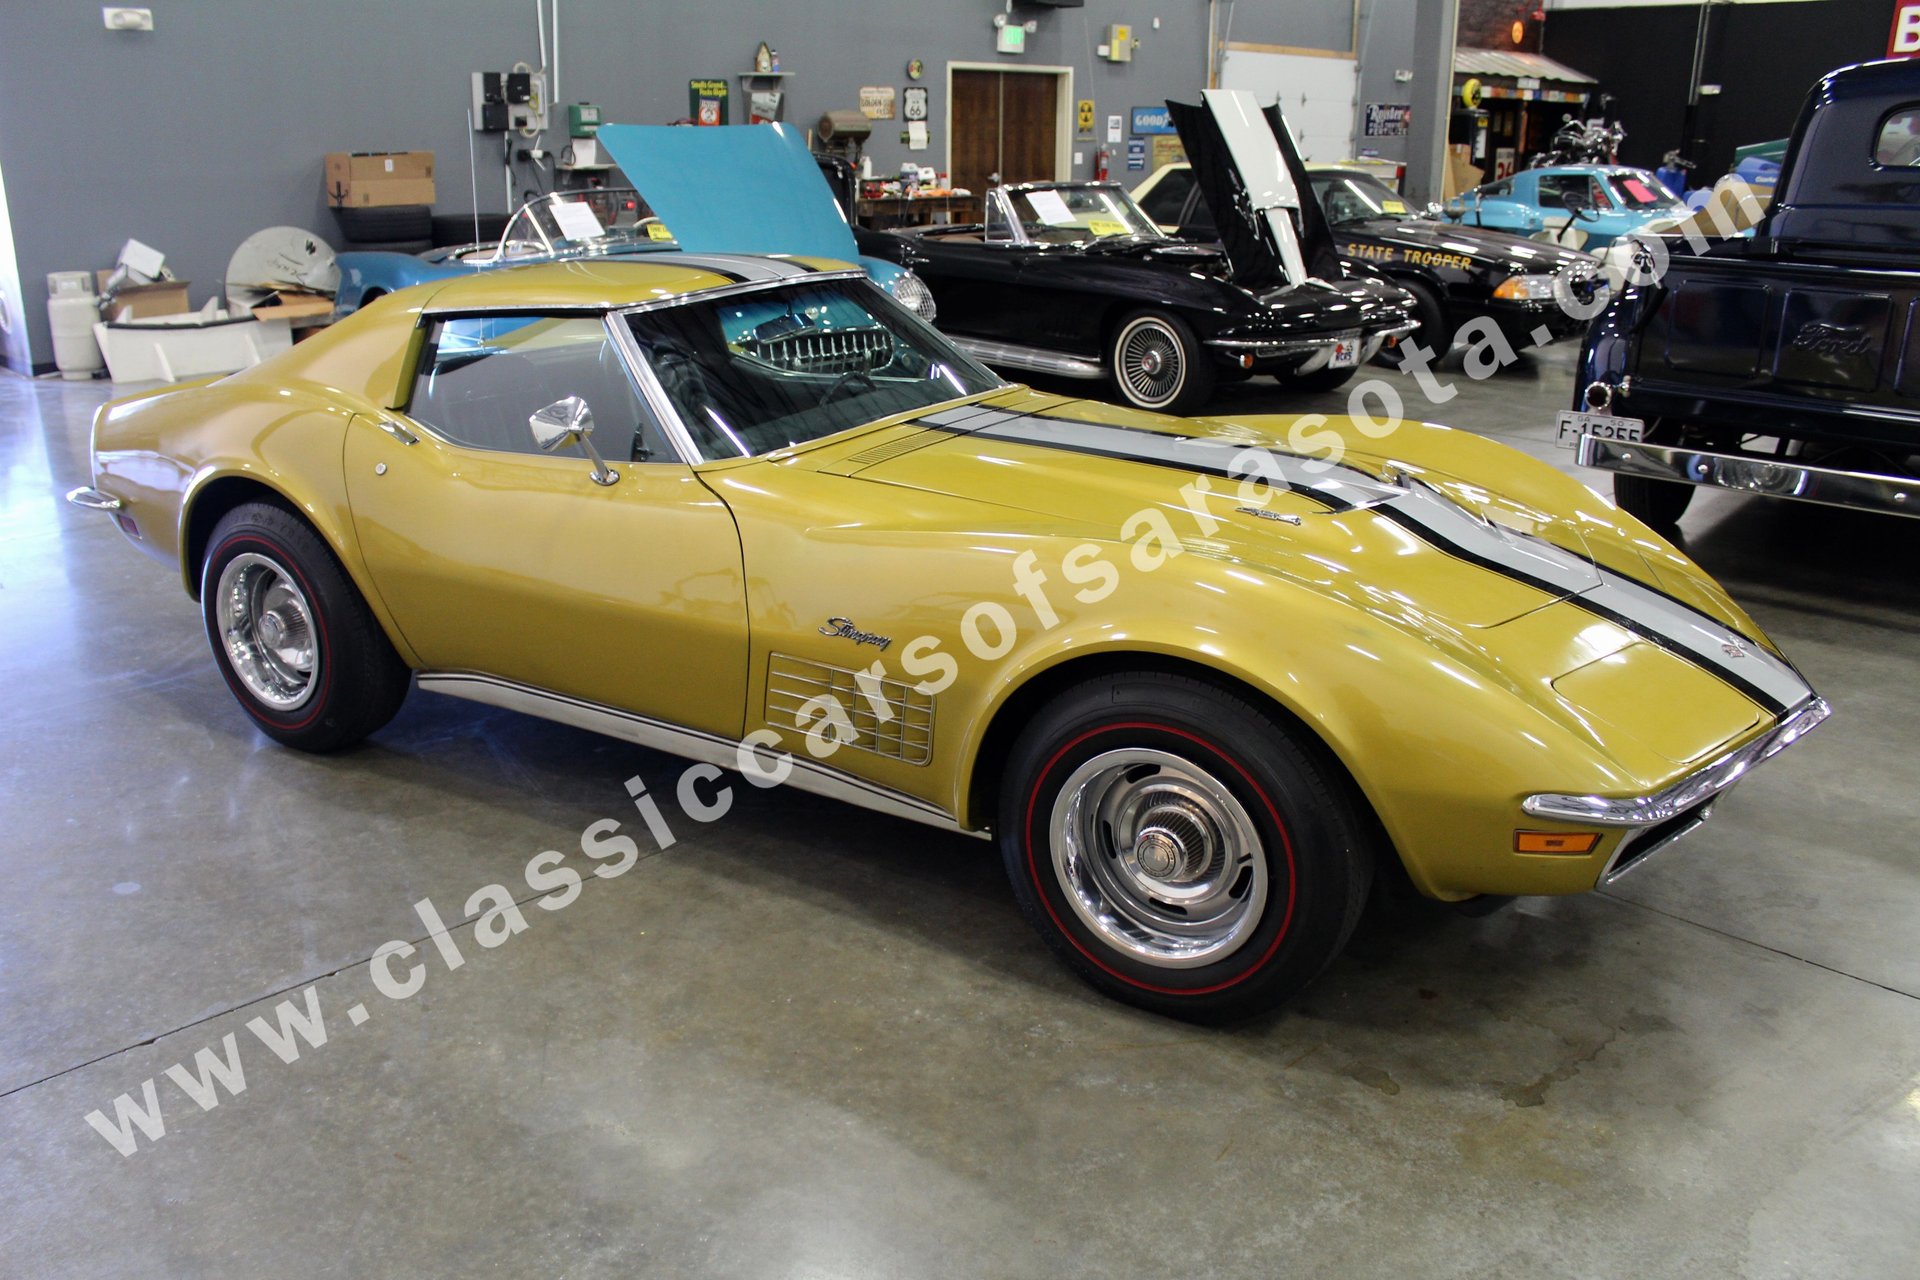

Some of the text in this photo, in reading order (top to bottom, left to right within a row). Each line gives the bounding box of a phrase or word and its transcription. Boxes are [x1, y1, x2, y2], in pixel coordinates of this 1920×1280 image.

[910, 106, 922, 116] 66
[1347, 243, 1472, 270] STATE TROOPER
